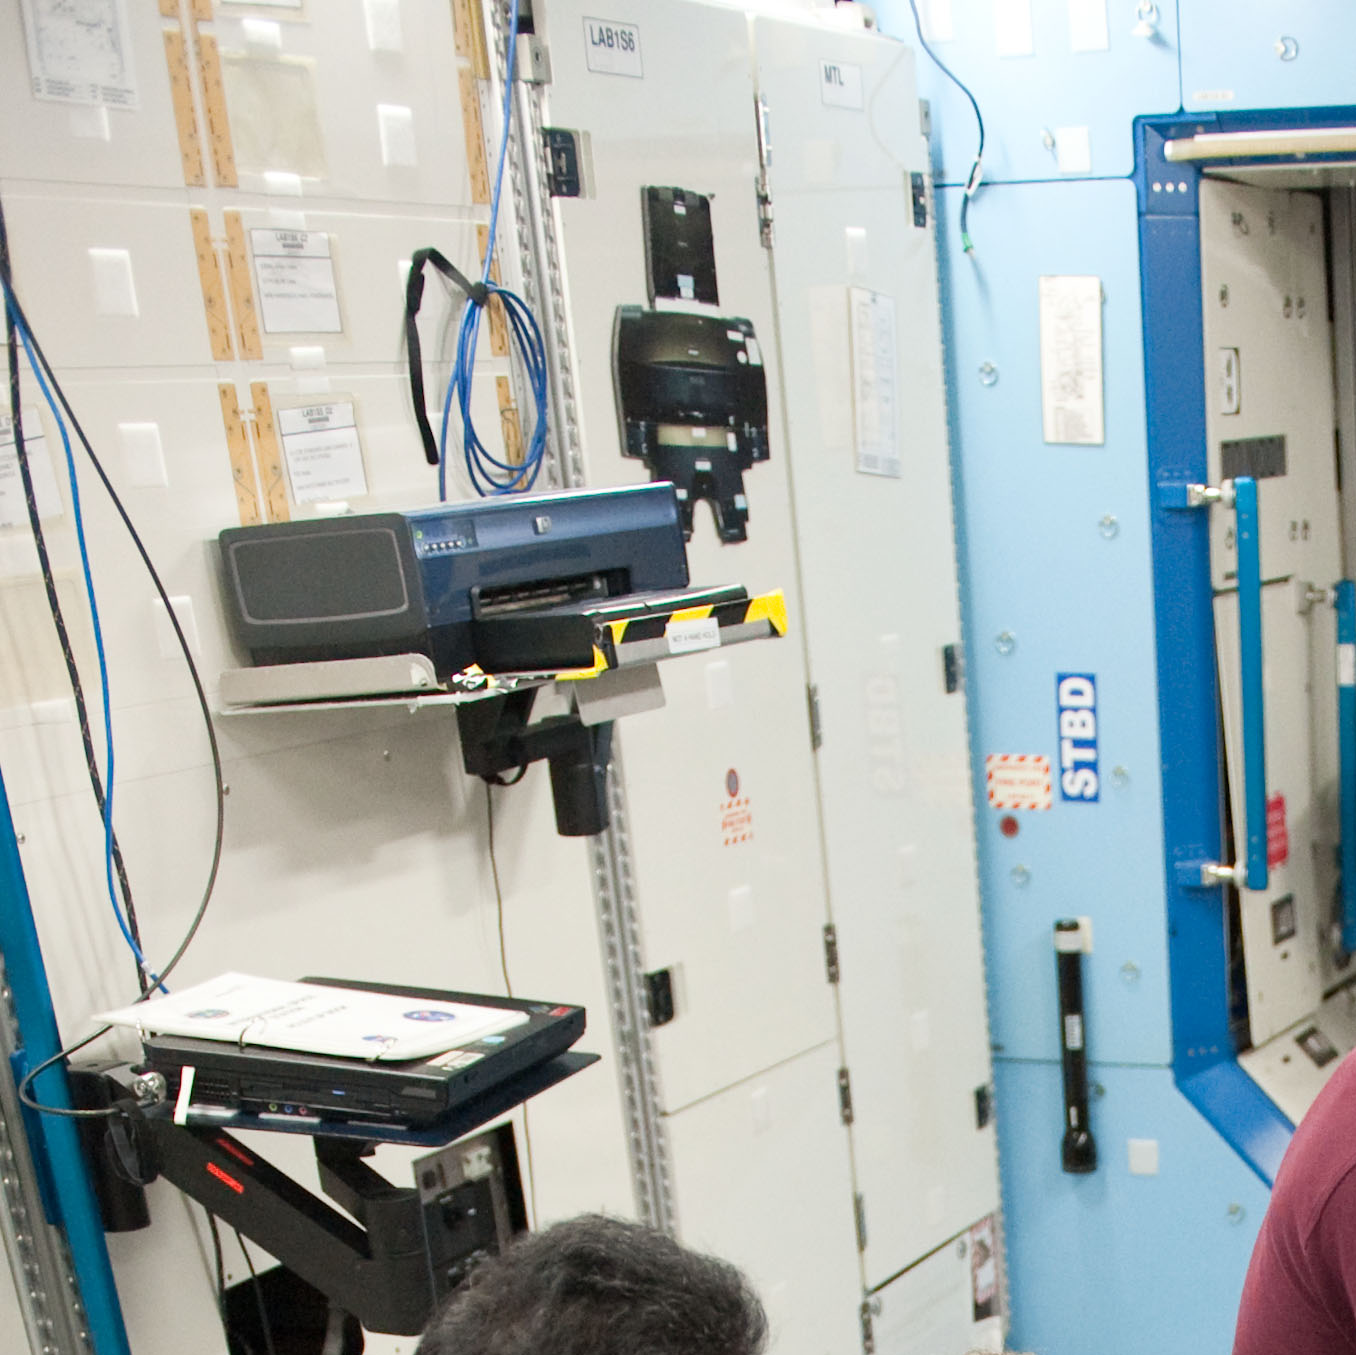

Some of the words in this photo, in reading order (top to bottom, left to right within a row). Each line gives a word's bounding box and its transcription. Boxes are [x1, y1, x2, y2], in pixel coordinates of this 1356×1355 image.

[589, 24, 636, 52] LAB1S6
[824, 64, 845, 86] MTL
[1059, 676, 1098, 799] STBD
